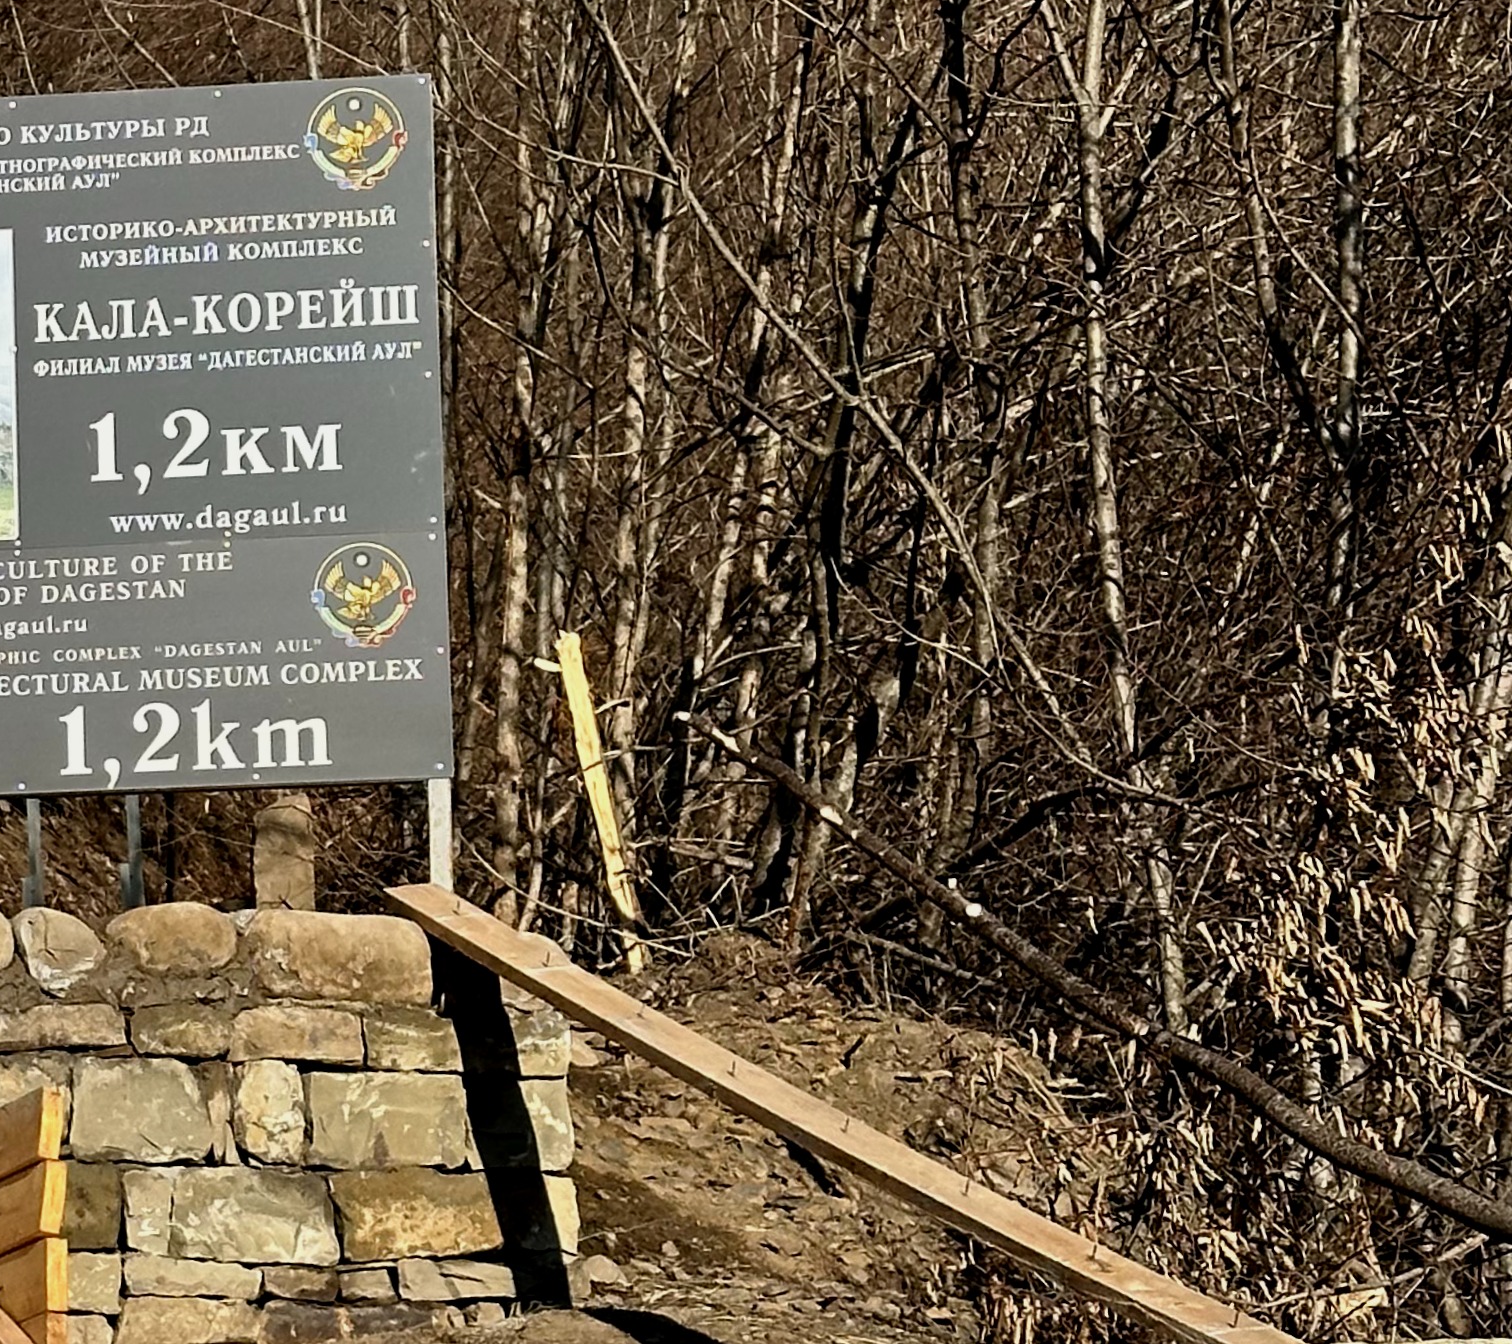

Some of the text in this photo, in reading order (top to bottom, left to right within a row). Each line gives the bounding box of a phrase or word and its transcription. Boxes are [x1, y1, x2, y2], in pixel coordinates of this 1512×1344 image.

[20, 118, 166, 145] КУЛЬТУРЫ
[174, 116, 210, 138] РД
[188, 143, 300, 164] КОМПЛЕКС
[45, 204, 397, 244] ИСТОРИКО-АРХИТЕКТУРНЫЙ
[79, 236, 364, 269] МУЗЕЙНЫЙ КОМПЛЕКС
[33, 278, 420, 343] КАЛА-КОРЕЙШ
[33, 356, 121, 377] ФИЛИАЛ
[126, 352, 193, 373] МУЗЕЯ
[109, 501, 347, 533] www.dagaul.ru
[130, 554, 166, 574] OF
[177, 551, 233, 572] THE
[40, 578, 186, 604] DAGESTAN
[52, 646, 142, 663] COMPLEX
[154, 640, 262, 658] “DAGESTAN
[137, 664, 271, 691] MUSEUM
[280, 658, 424, 685] COMPLEX
[58, 698, 333, 793] 1,2km
